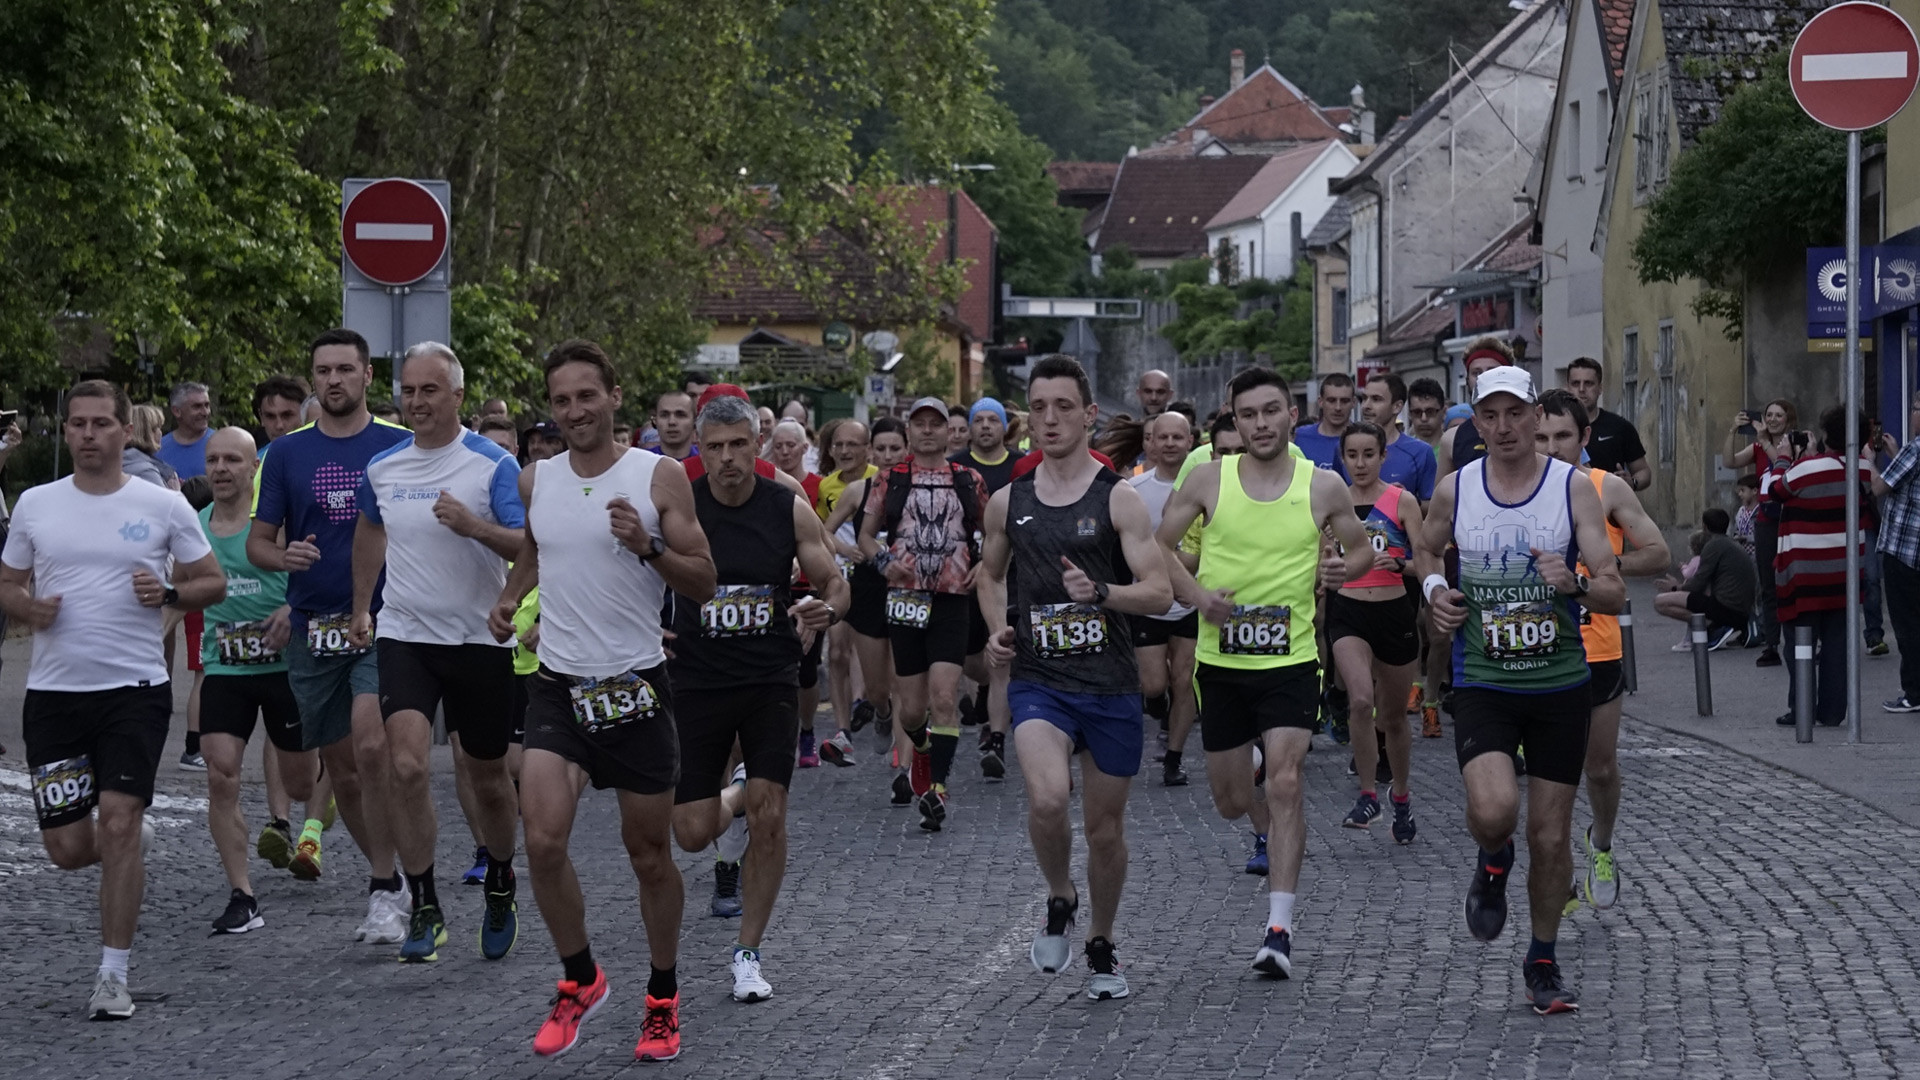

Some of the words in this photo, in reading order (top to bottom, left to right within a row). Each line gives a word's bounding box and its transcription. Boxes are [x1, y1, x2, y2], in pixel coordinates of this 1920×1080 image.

[327, 490, 354, 498] ZAGREB
[327, 496, 346, 504] LOVE
[1472, 584, 1557, 602] MAKSIMIR
[706, 603, 770, 629] 1015
[887, 600, 928, 622] 1096
[1036, 619, 1103, 648] 1138
[1223, 622, 1287, 646] 1062
[1487, 619, 1556, 648] 1109
[579, 686, 655, 721] 1134
[36, 773, 93, 809] 1092
